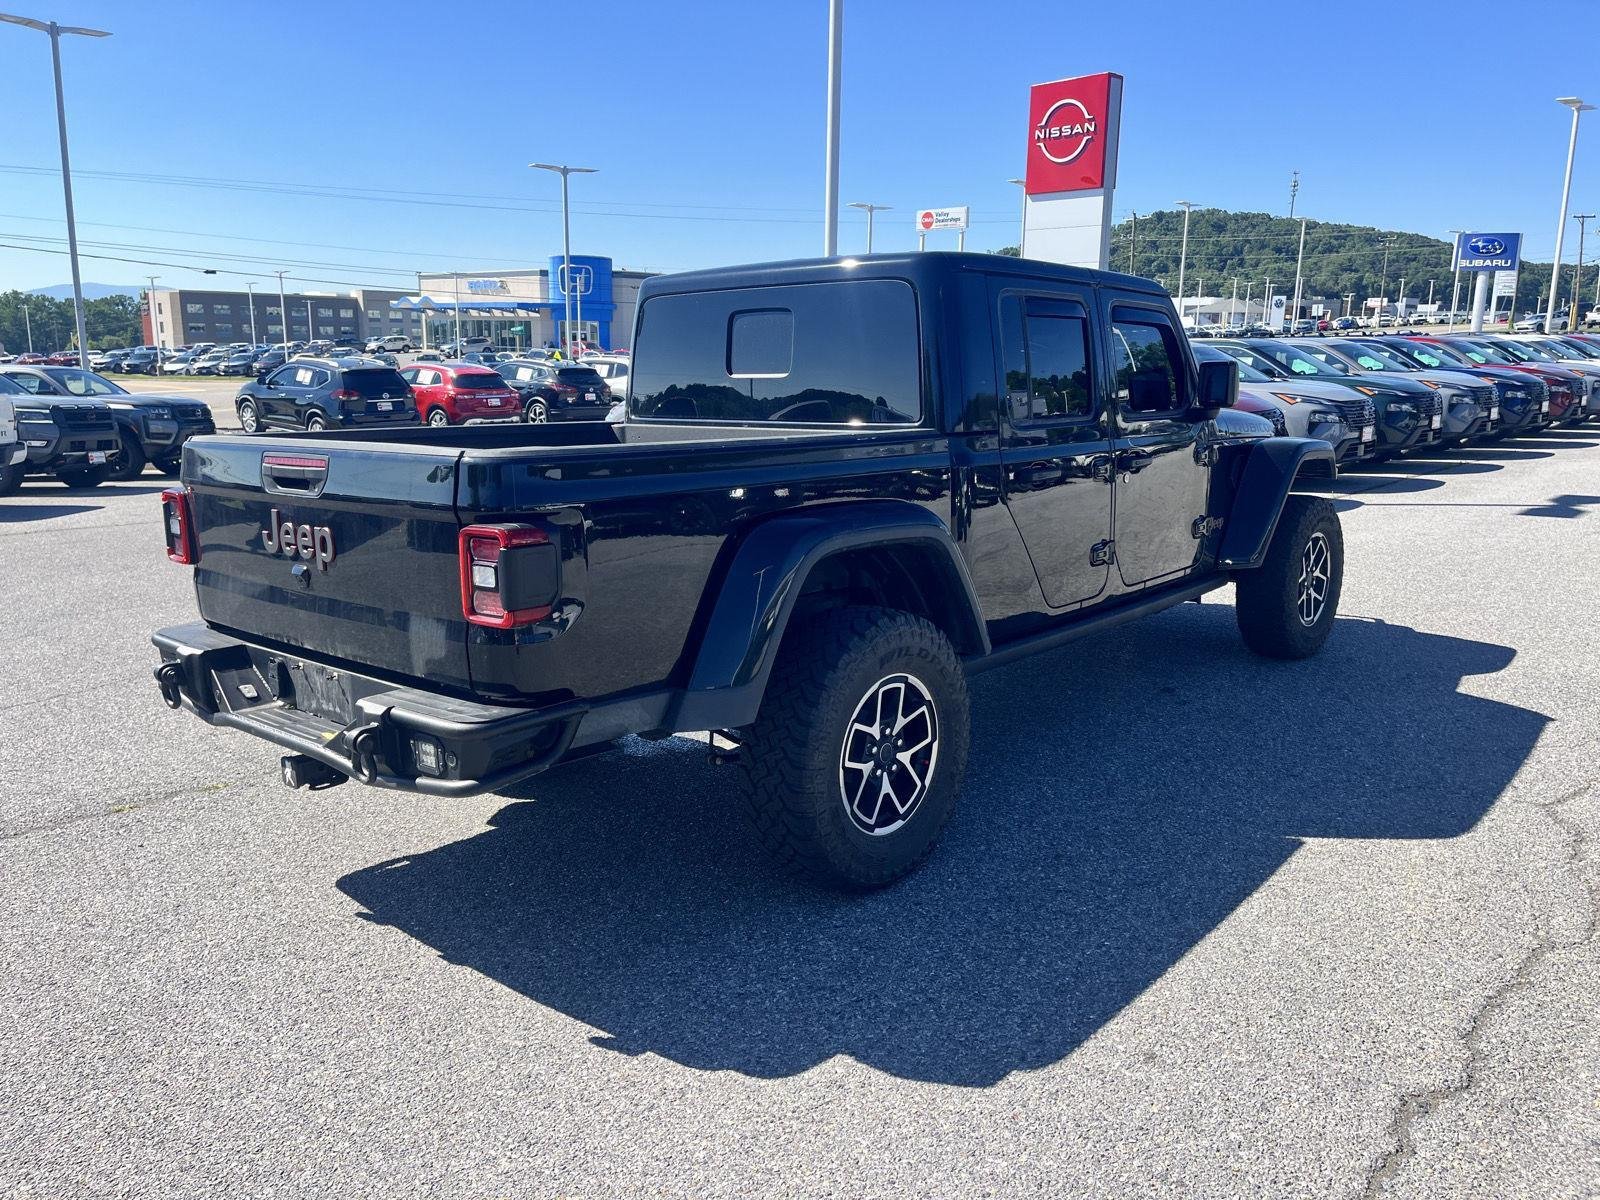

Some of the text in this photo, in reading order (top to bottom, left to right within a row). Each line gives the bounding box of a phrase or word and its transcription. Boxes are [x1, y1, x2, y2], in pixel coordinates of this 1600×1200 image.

[1035, 121, 1095, 140] NISSAN
[1459, 259, 1512, 267] SUBARU
[262, 508, 336, 571] Jeep
